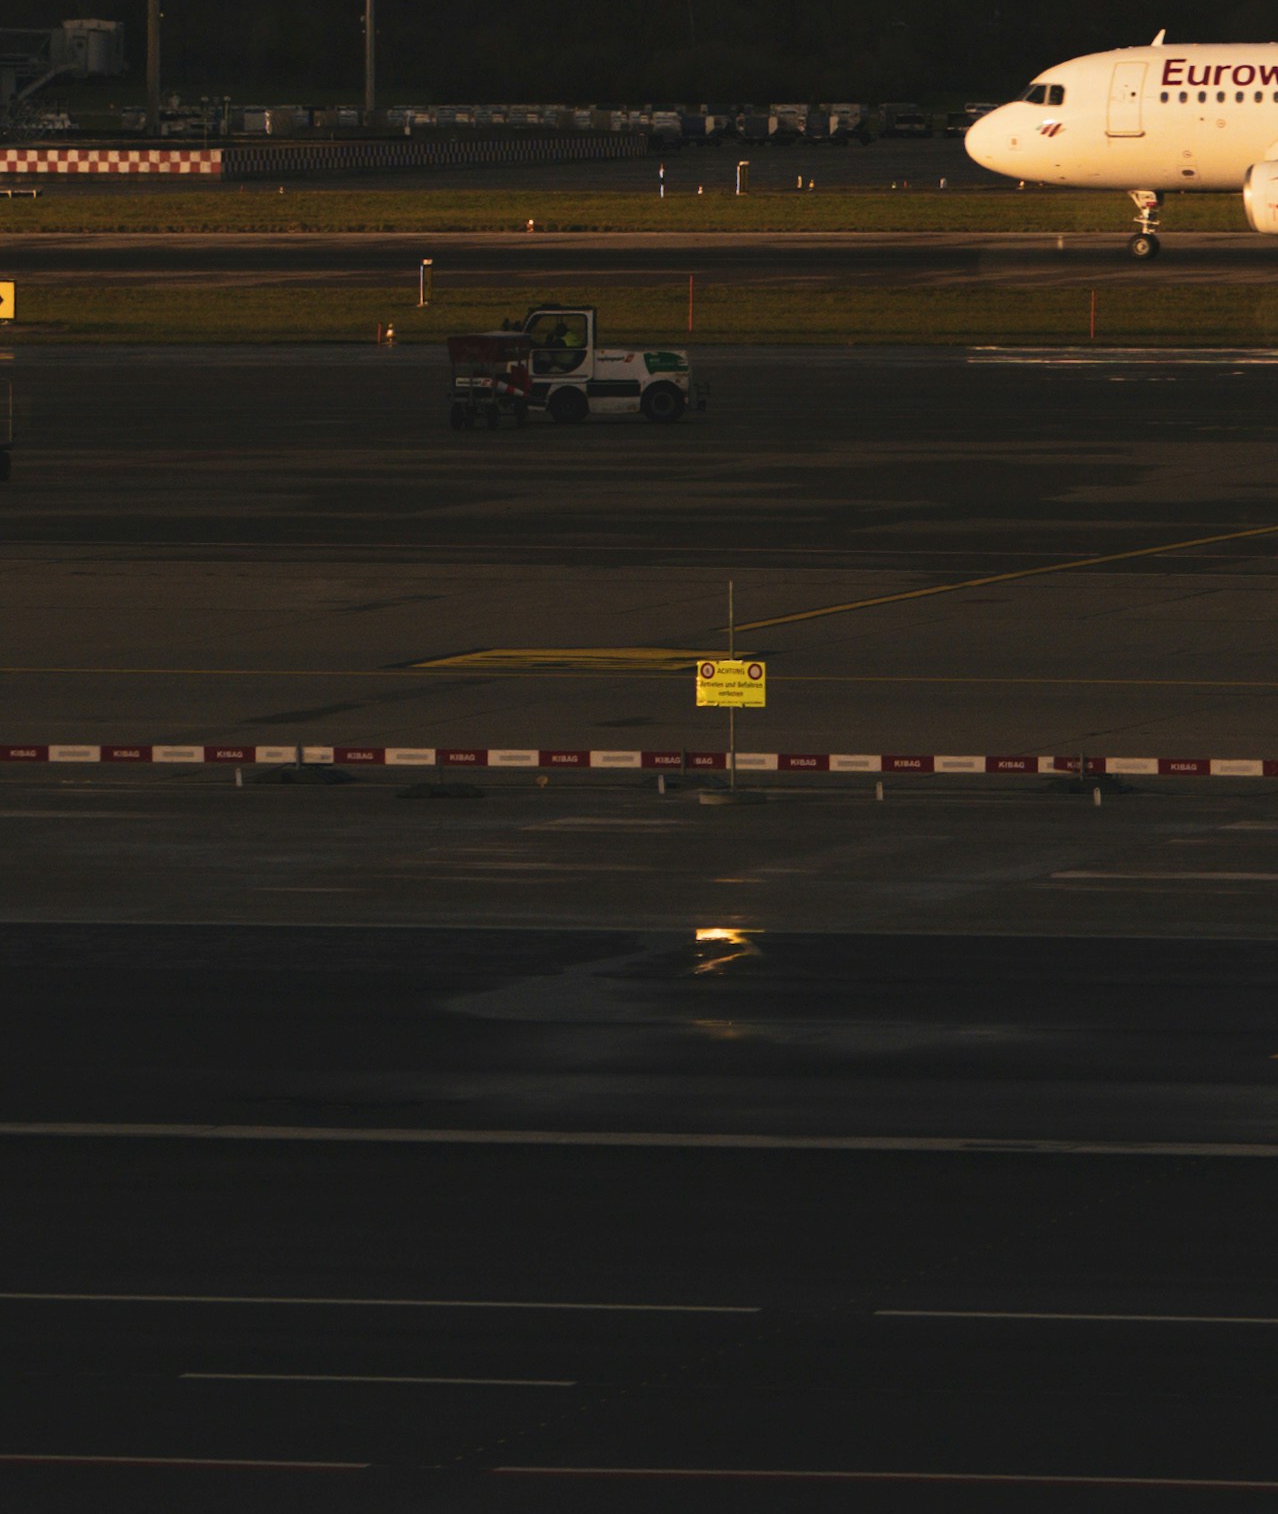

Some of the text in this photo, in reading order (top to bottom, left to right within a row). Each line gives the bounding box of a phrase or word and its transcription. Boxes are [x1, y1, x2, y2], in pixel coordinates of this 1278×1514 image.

[9, 749, 37, 758] KIBAG
[113, 750, 140, 758] KIBAG
[216, 750, 244, 758] KIBAG
[346, 752, 374, 760] KIBAG
[449, 753, 476, 762] KIBAG
[551, 754, 579, 763] KIBAG
[654, 756, 681, 765] KIBAG
[790, 758, 817, 767] KIBAG
[893, 760, 921, 768] KIBAG
[998, 761, 1025, 769] KIBAG
[1170, 763, 1198, 771] KIBAG
